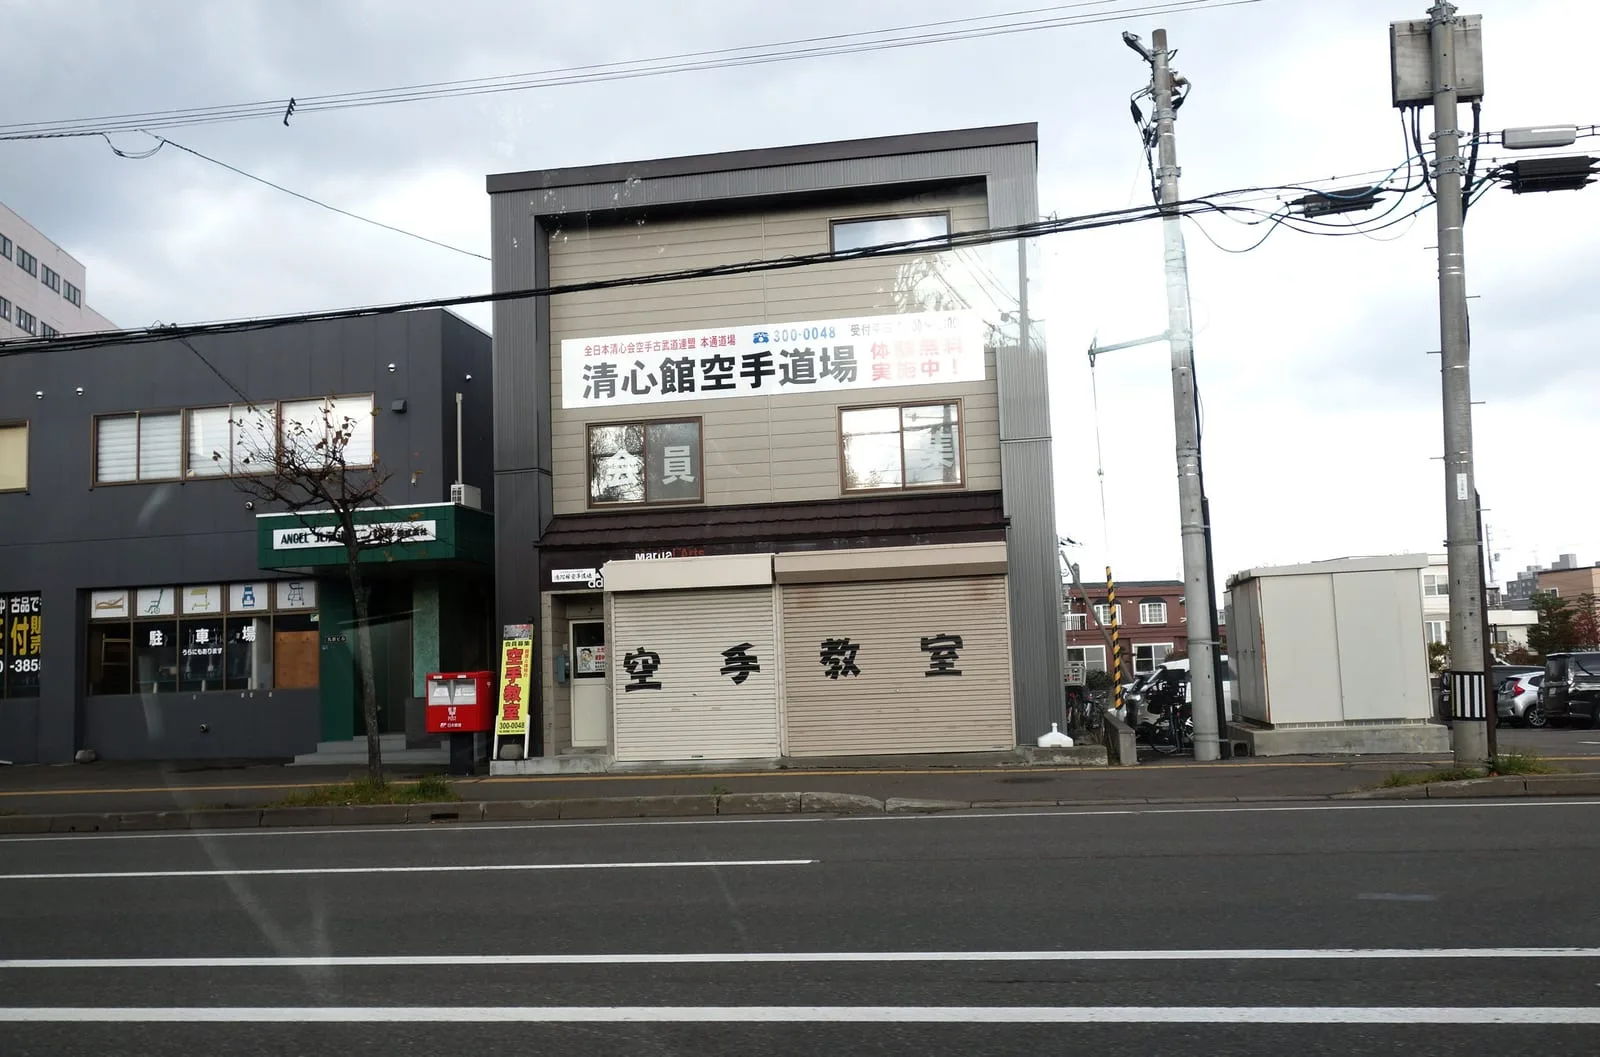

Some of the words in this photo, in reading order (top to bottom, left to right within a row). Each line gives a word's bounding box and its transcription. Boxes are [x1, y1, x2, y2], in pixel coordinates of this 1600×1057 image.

[584, 337, 696, 357] 全日本清心会空手古武道連盟
[700, 334, 736, 349] 本通道場
[773, 326, 836, 343] 300-0048
[583, 345, 858, 400] 清心館空手道場
[149, 626, 257, 647] 駐車場
[623, 633, 964, 693] 空手教室
[502, 648, 523, 720] 空手教室
